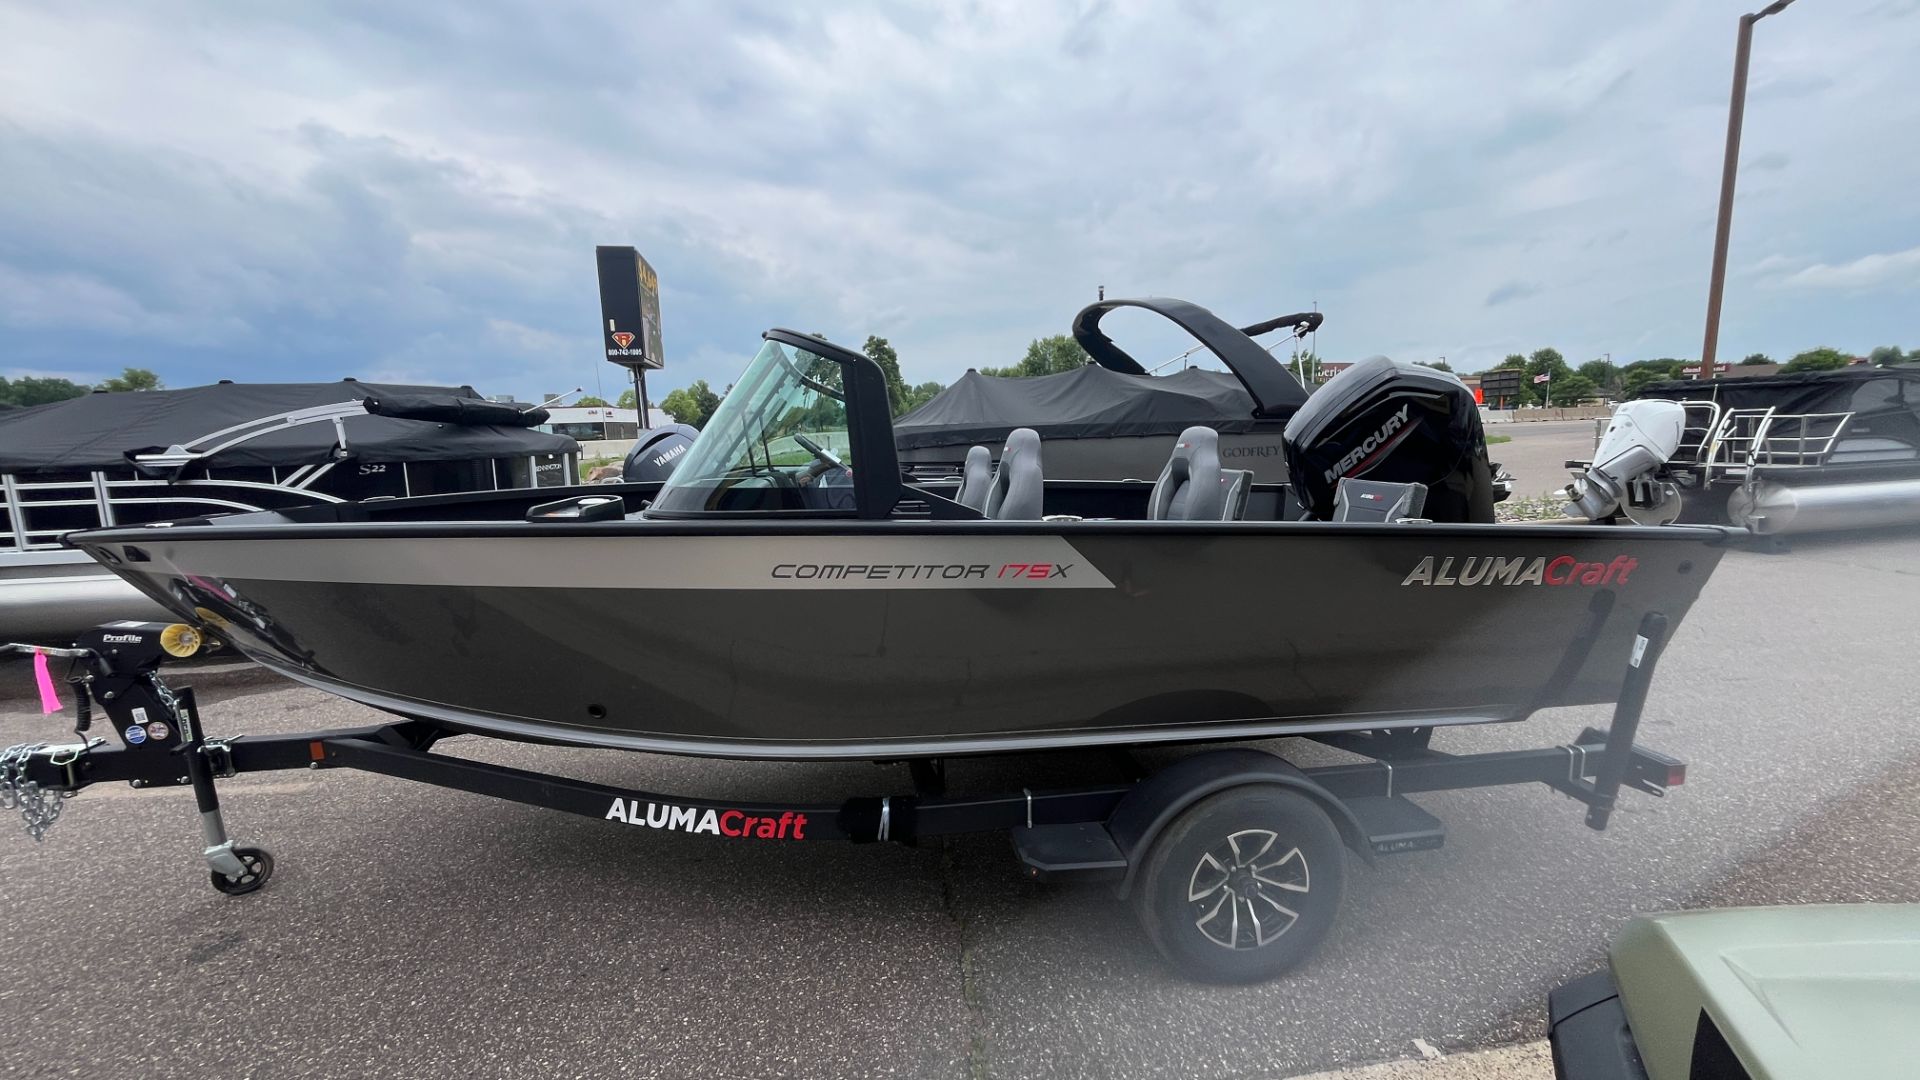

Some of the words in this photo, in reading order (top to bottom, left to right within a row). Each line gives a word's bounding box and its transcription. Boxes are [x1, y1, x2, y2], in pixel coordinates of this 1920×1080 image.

[653, 444, 686, 467] YAMAHA
[1222, 445, 1280, 458] GODFREY
[1323, 403, 1409, 485] MERCURY
[771, 563, 990, 579] COMPETITOR
[996, 563, 1074, 579] 175X
[1401, 554, 1640, 587] ALUMACraft
[103, 633, 142, 643] Profile
[605, 797, 808, 840] ALUMACraft
